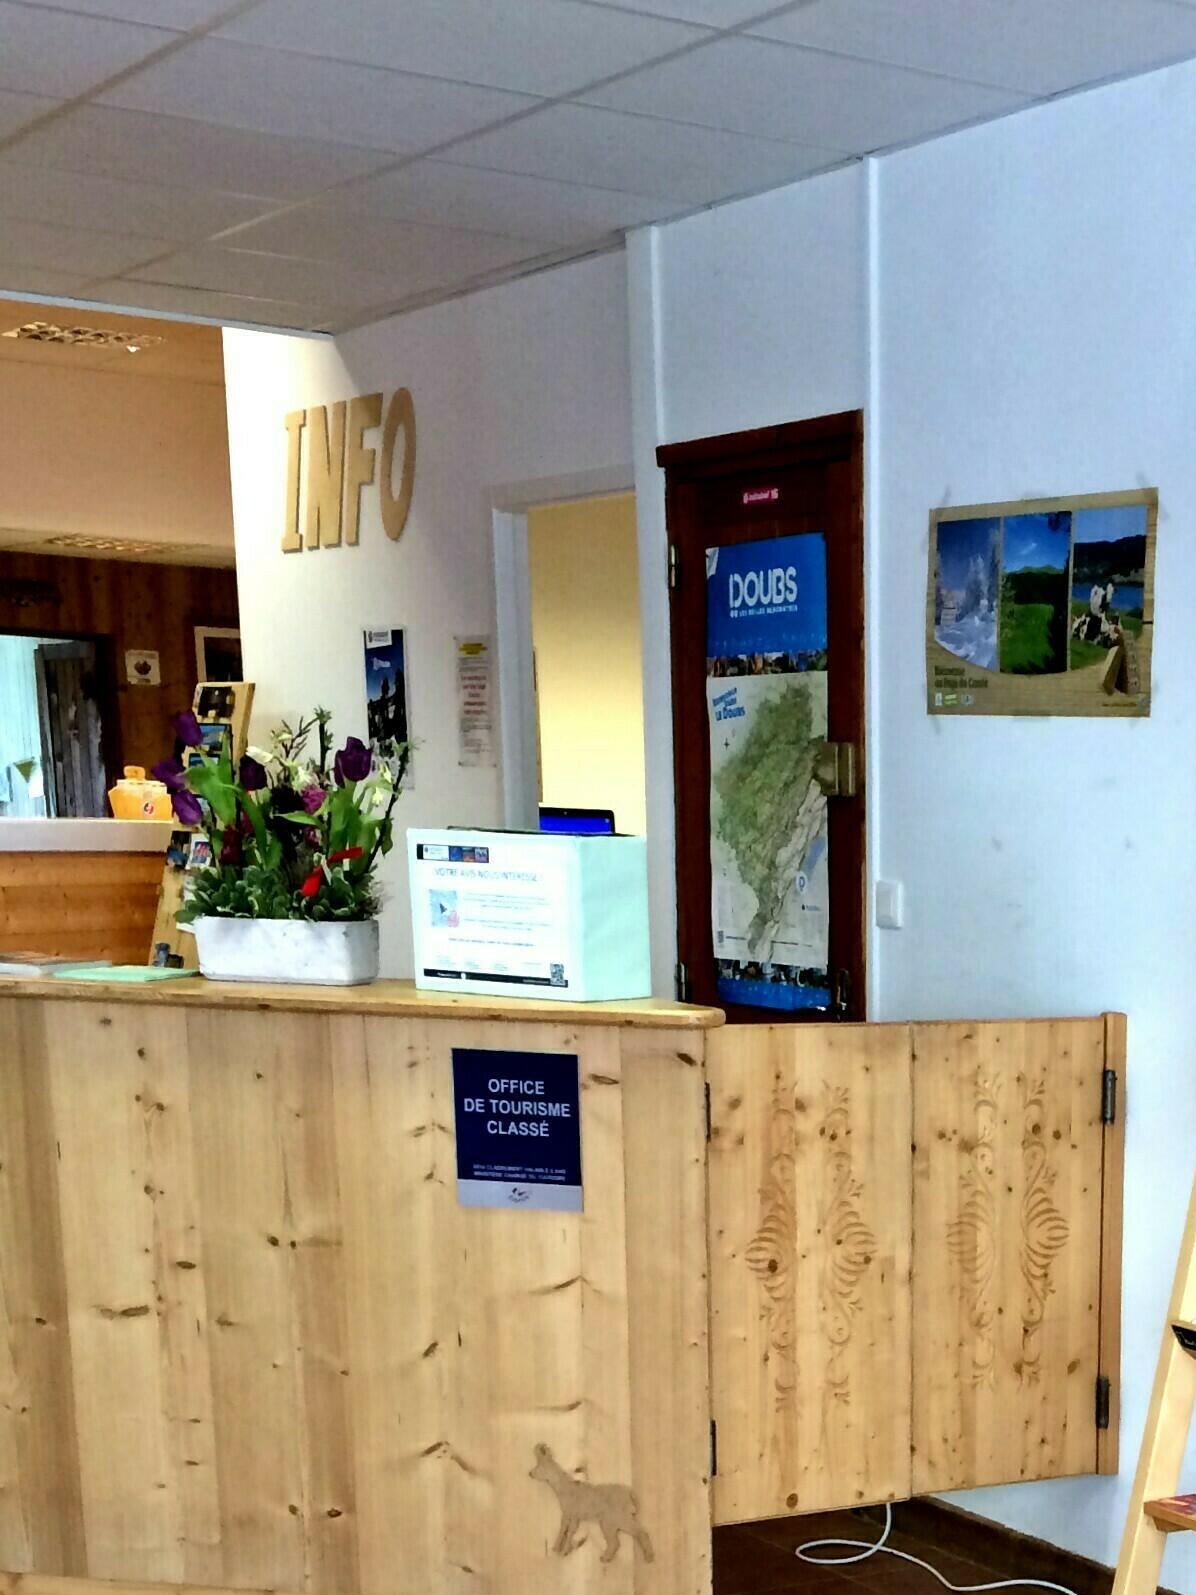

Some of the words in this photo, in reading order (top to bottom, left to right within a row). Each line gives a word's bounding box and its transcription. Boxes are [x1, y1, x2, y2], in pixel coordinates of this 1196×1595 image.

[282, 387, 416, 553] INFO
[729, 566, 798, 608] DOUBS
[488, 1079, 545, 1094] OFFICE
[464, 1098, 485, 1112] DE
[490, 1099, 571, 1117] TOURISME
[487, 1120, 550, 1137] CLASSÉ
